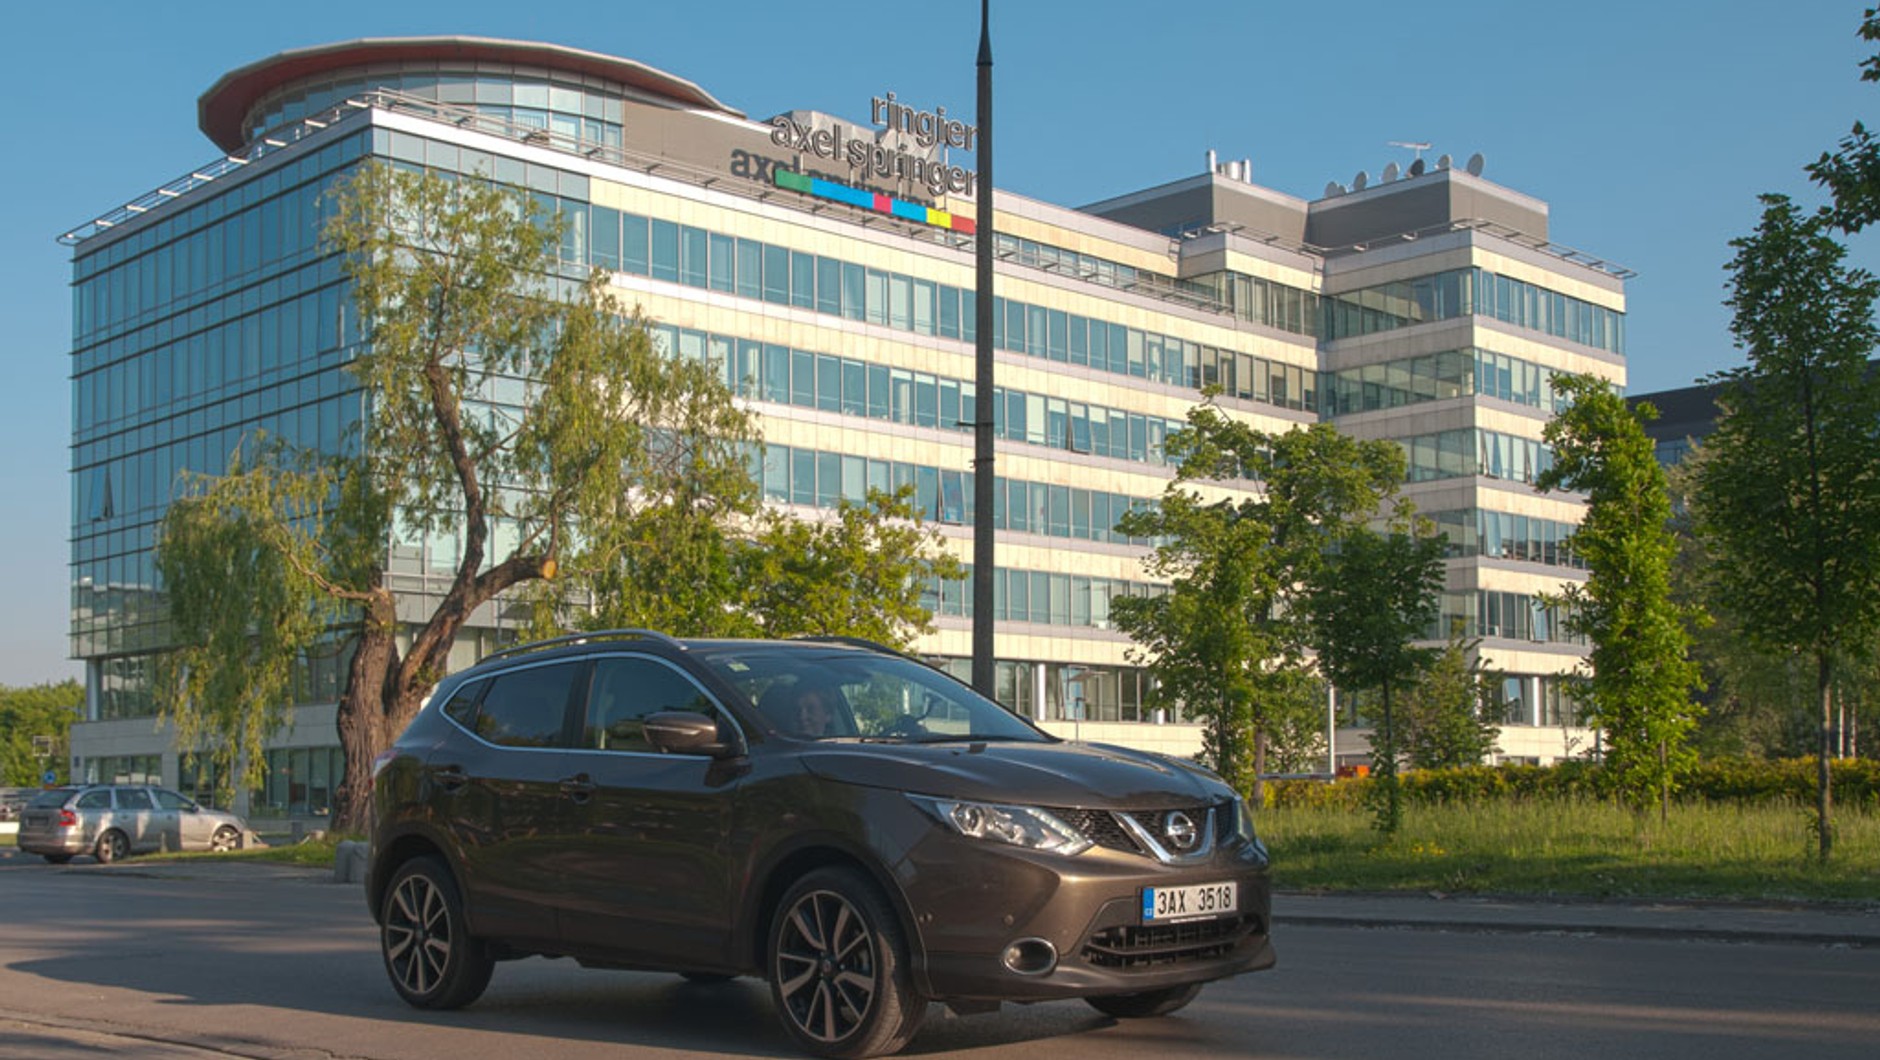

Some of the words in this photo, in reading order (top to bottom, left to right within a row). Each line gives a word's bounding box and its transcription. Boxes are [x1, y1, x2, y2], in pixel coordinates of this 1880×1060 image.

[871, 92, 978, 151] ringier
[770, 115, 841, 161] axel
[846, 138, 978, 196] springer
[1158, 890, 1186, 915] 3AX
[1198, 886, 1232, 911] 3518
